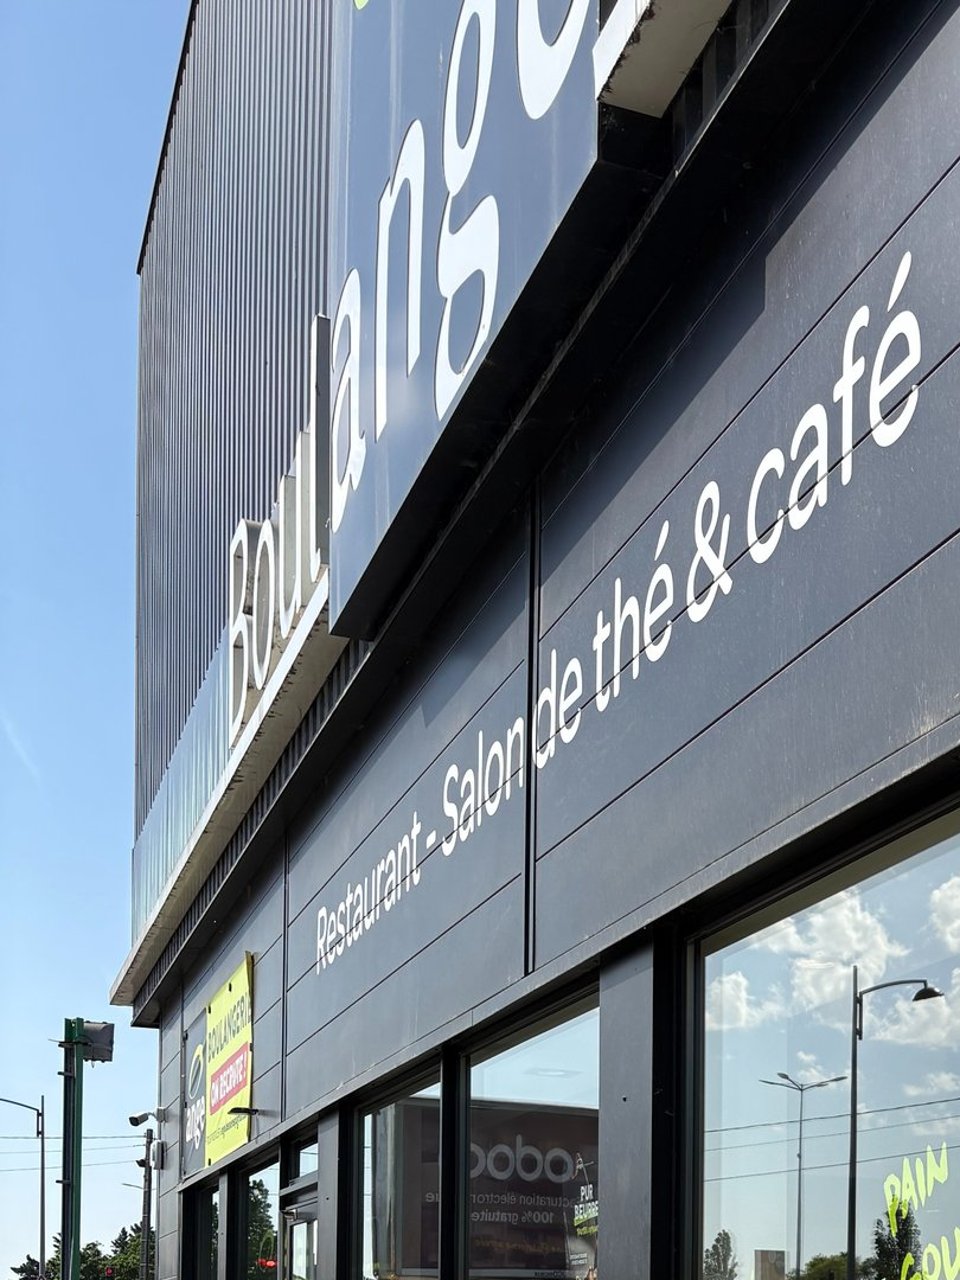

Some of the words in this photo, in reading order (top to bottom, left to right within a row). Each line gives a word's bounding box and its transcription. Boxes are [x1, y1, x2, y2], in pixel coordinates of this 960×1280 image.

[316, 809, 422, 975] Restaurant
[441, 714, 525, 857] Salon
[533, 639, 583, 769] de
[591, 520, 673, 713] thé
[686, 480, 732, 623] &
[746, 251, 922, 564] café
[186, 1096, 205, 1150] ange
[580, 1184, 594, 1201] PUR
[884, 1141, 948, 1237] PAIN
